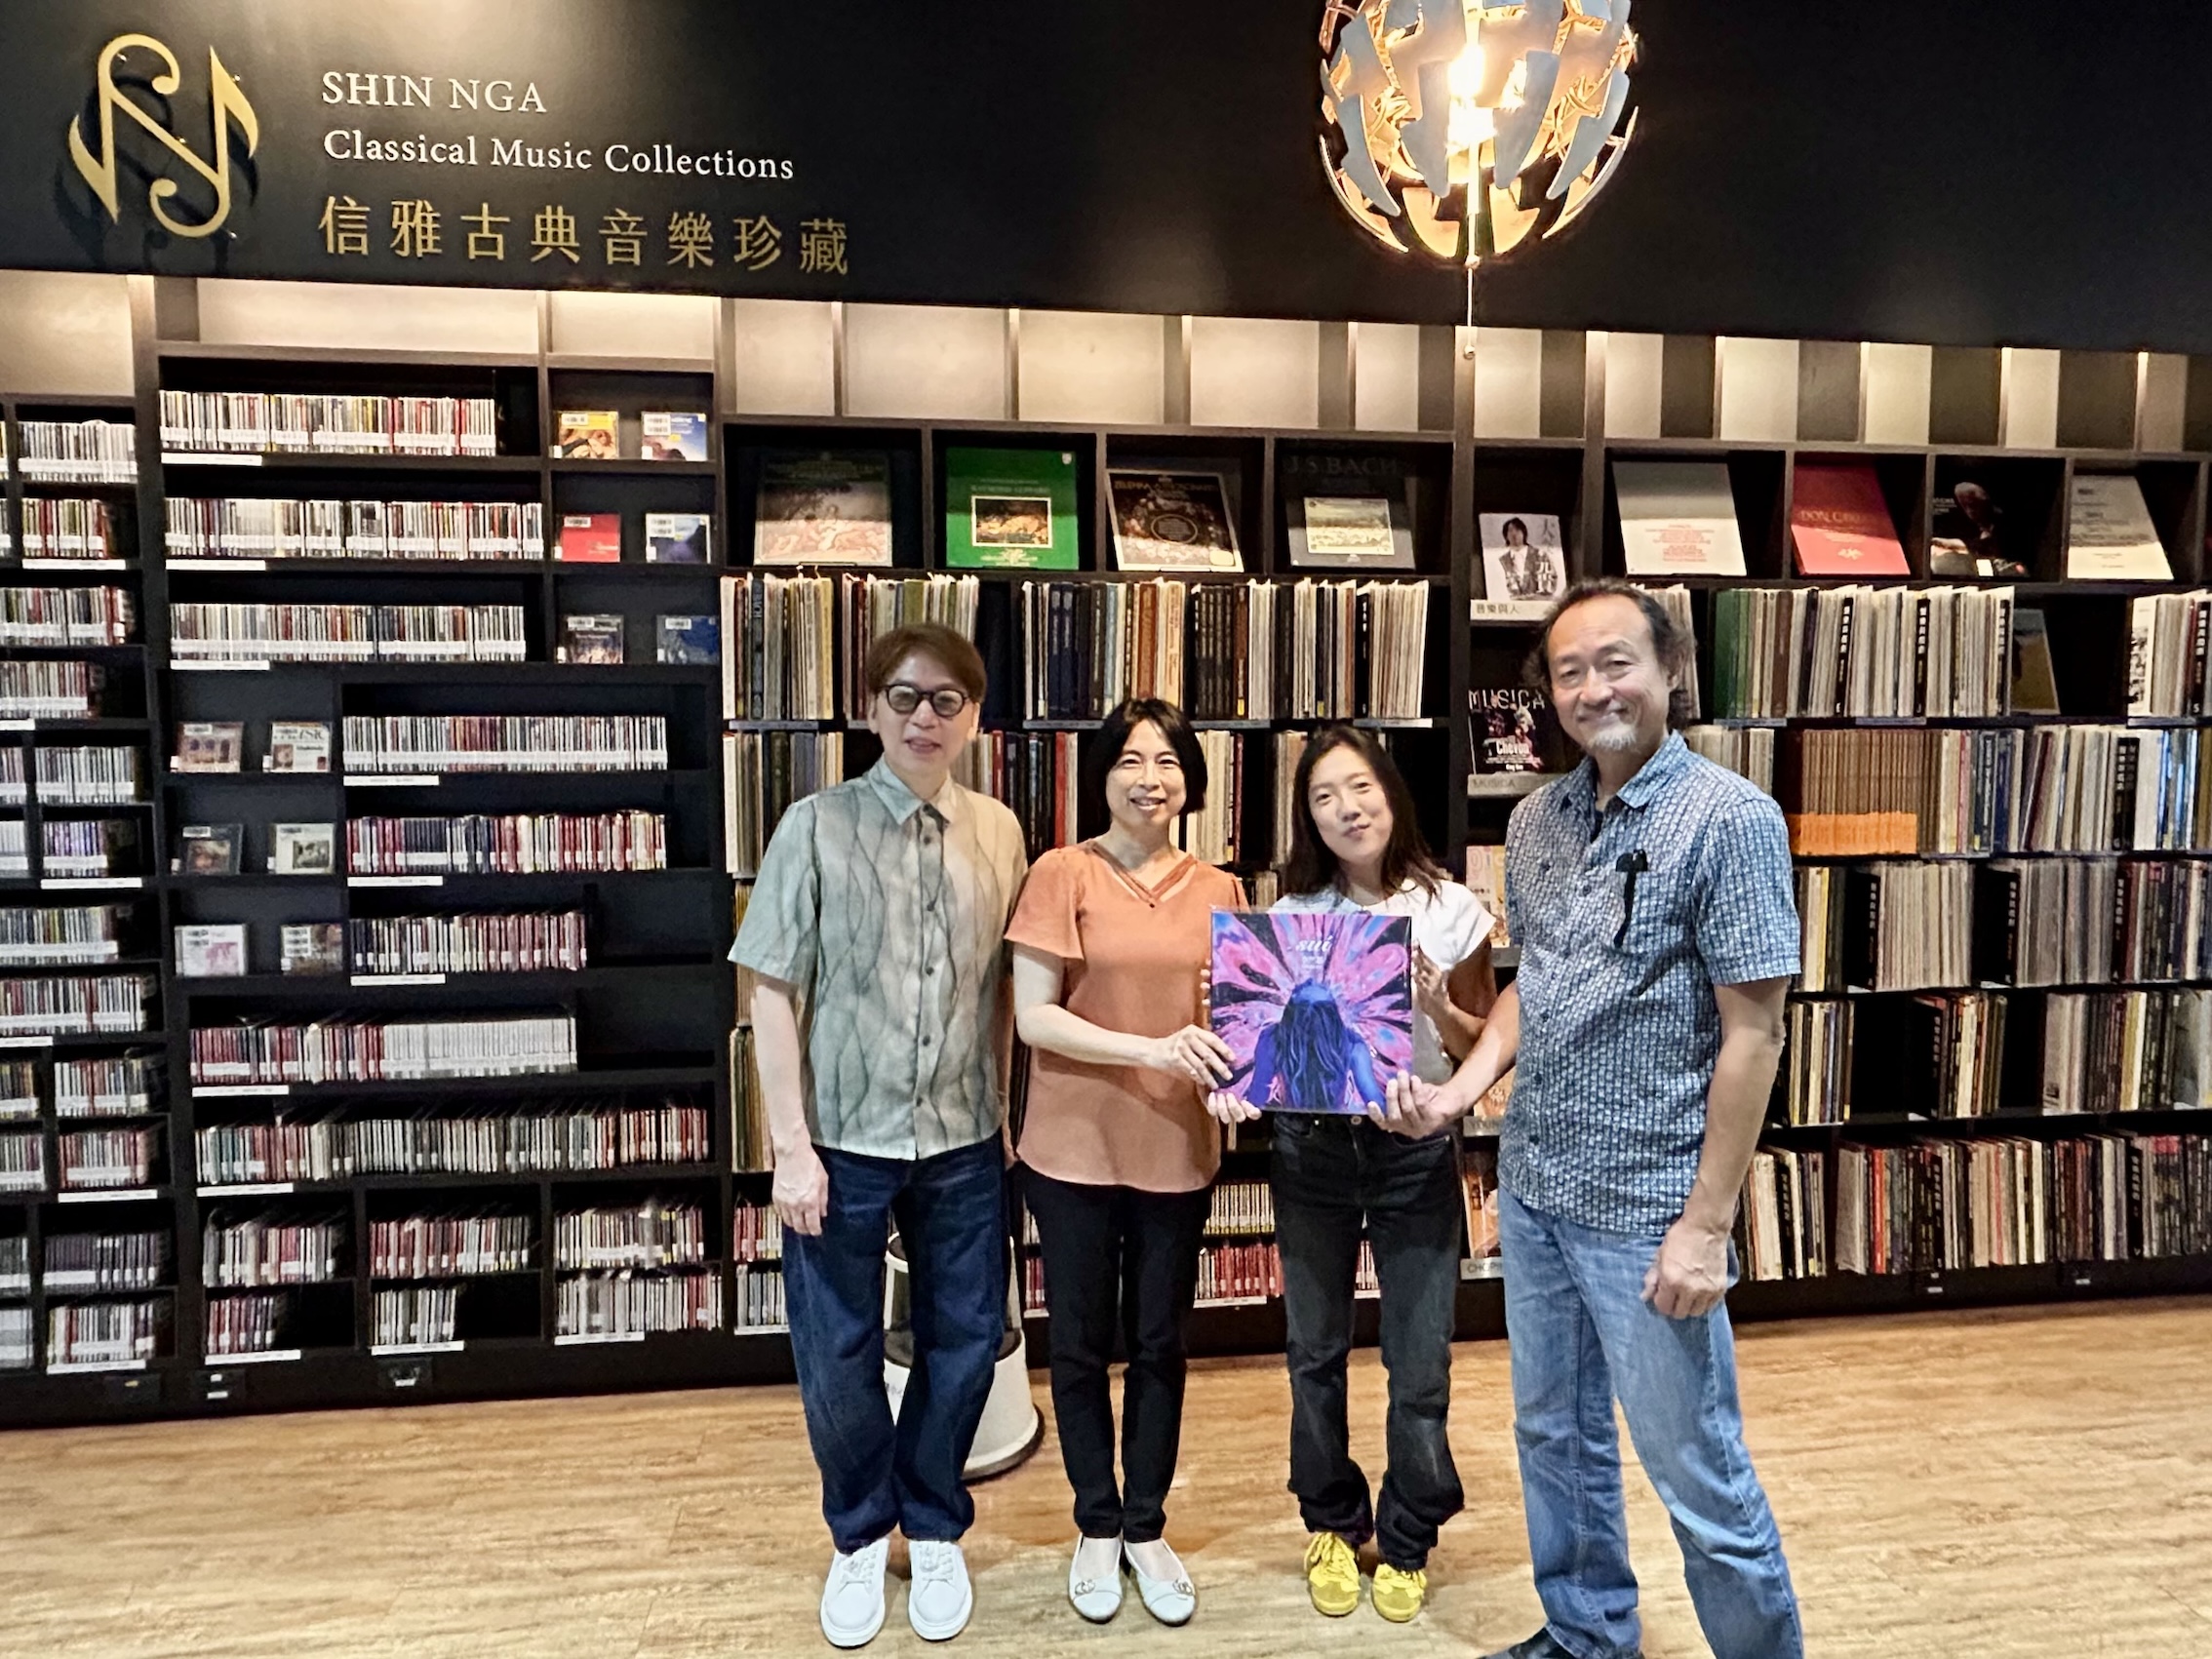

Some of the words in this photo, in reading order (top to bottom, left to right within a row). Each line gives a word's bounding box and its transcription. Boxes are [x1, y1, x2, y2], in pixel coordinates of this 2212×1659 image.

[321, 71, 432, 108] SHIN
[448, 78, 547, 114] NGA
[323, 129, 477, 167] Classical
[491, 138, 592, 171] Music
[605, 143, 795, 181] Collections
[318, 194, 849, 277] 信雅古典音樂珍藏
